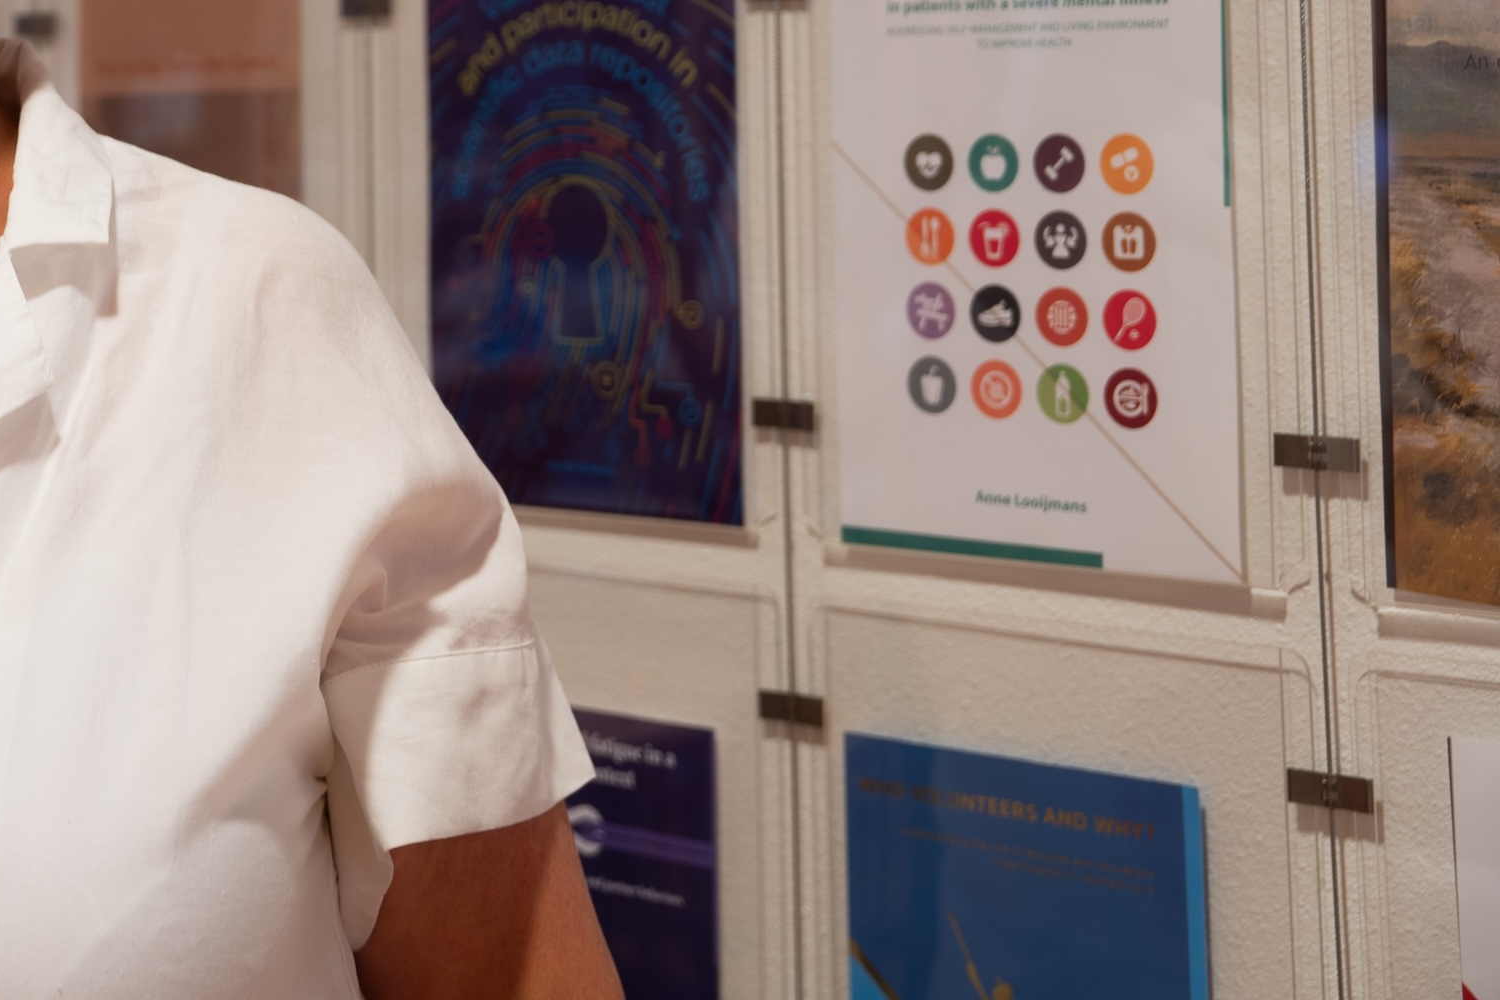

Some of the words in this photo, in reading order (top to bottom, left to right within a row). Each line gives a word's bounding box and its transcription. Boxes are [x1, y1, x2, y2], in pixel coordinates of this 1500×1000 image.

[1000, 0, 1009, 10] a
[457, 29, 504, 96] and
[668, 47, 699, 88] in
[522, 40, 586, 76] data
[1464, 52, 1489, 71] An
[975, 488, 1011, 506] Anne
[910, 782, 1038, 823] VOLUNTEERS
[1043, 806, 1088, 831] AND
[1092, 815, 1156, 840] WHY?
